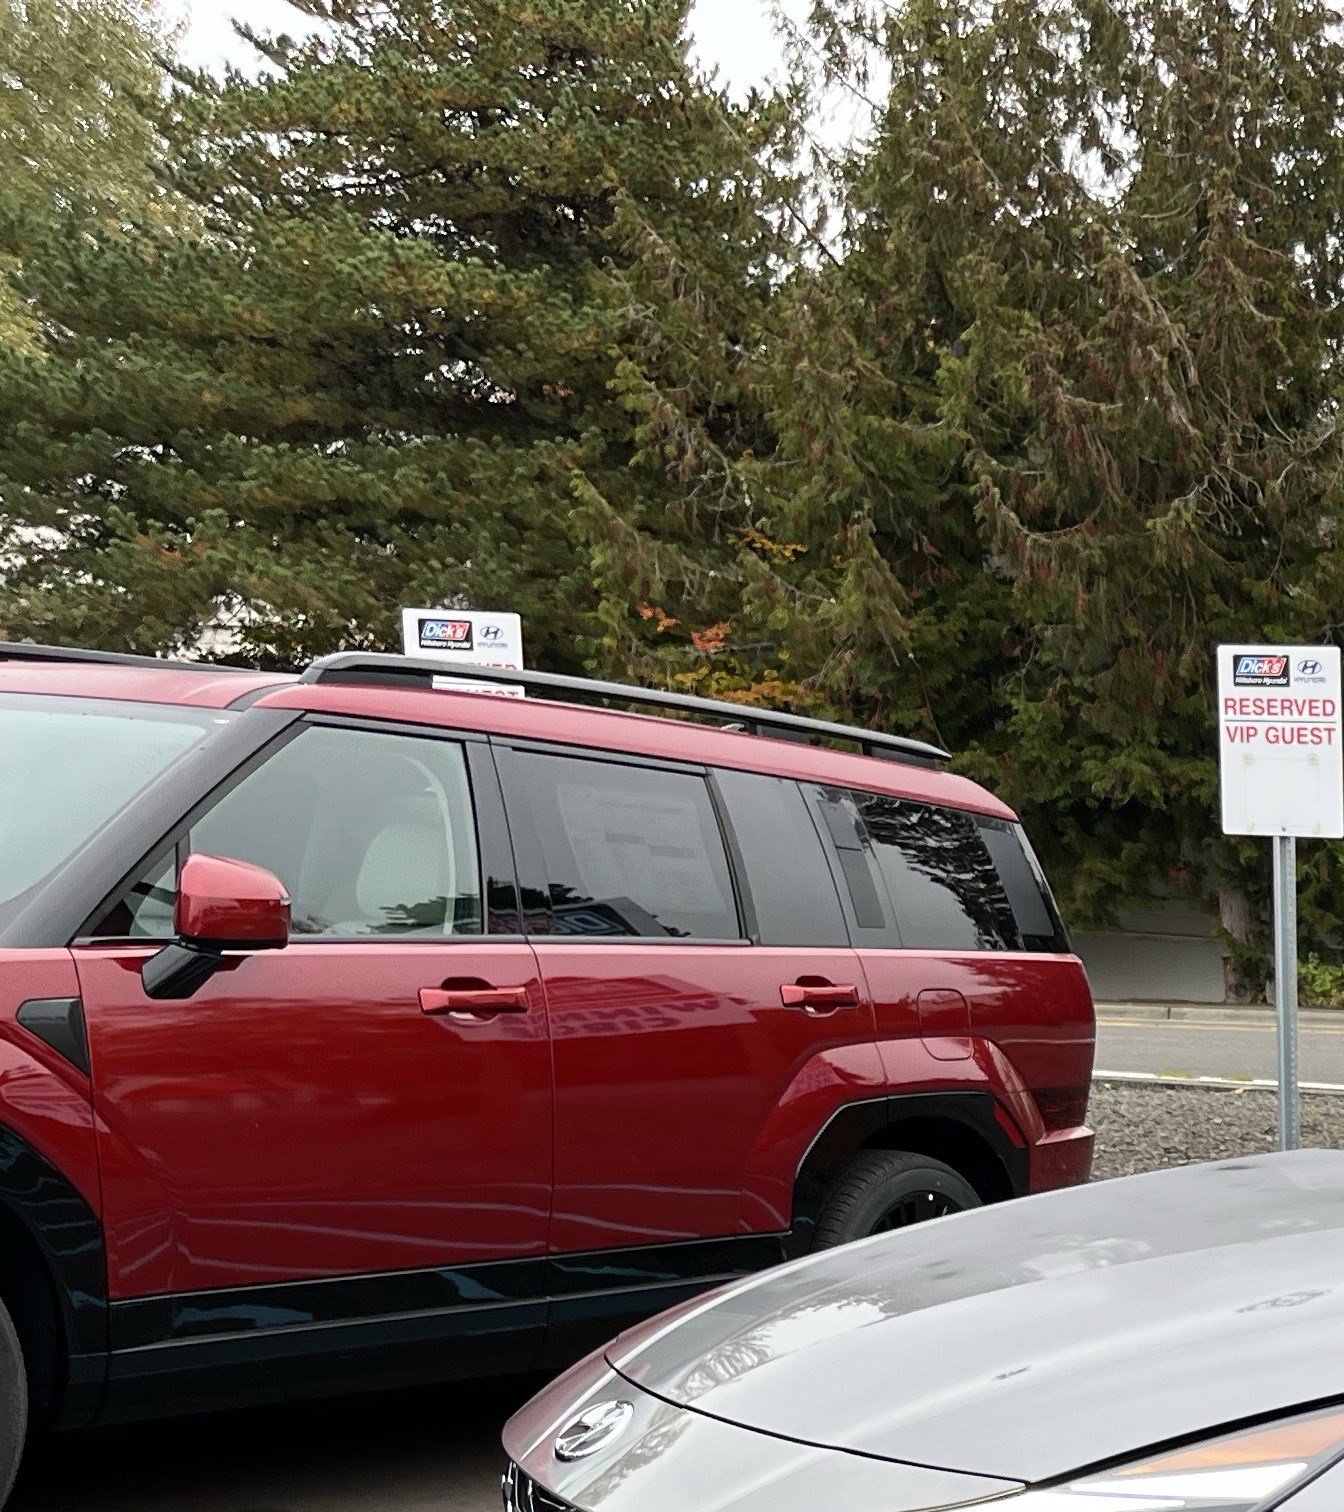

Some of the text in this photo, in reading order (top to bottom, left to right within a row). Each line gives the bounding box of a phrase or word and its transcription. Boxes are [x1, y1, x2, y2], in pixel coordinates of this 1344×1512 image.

[1224, 698, 1336, 717] RESERVED
[1226, 726, 1336, 745] VIP GUEST
